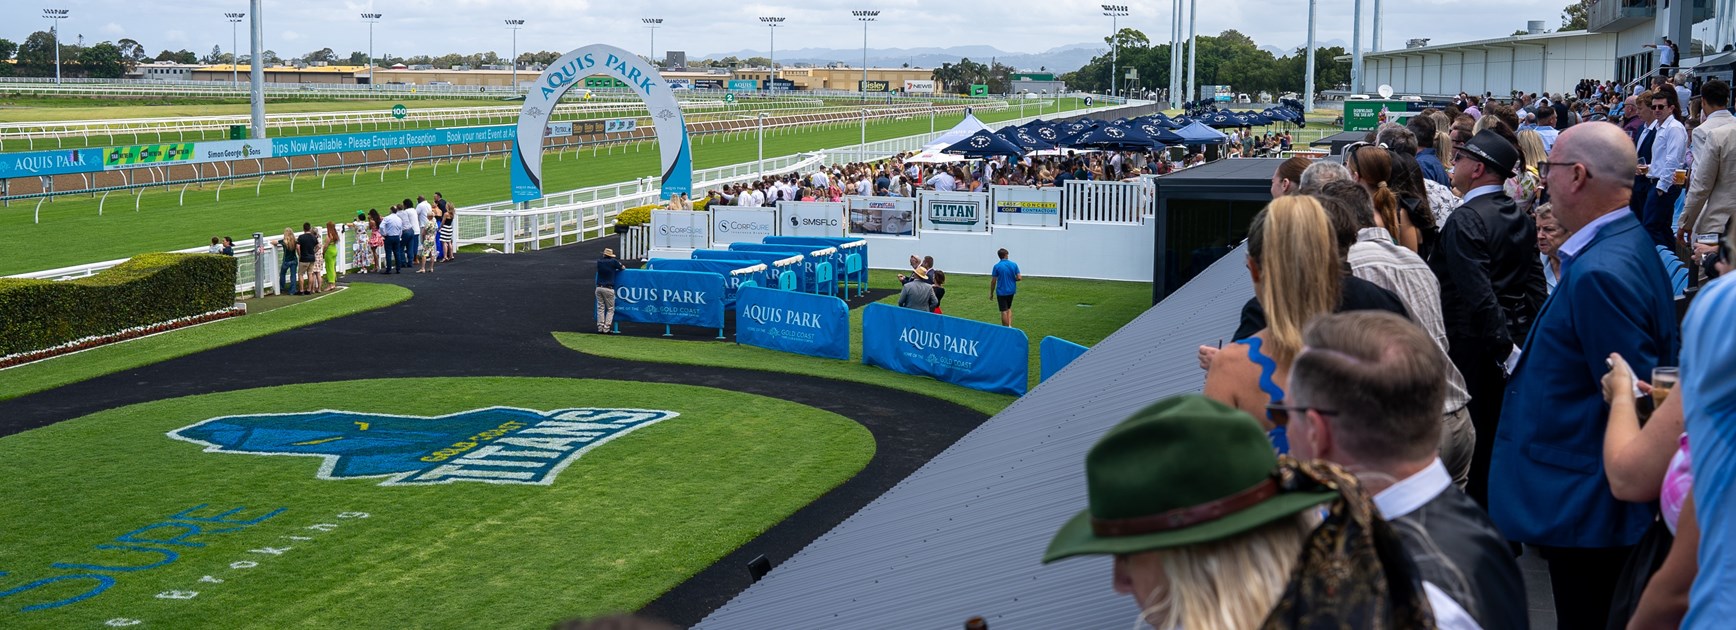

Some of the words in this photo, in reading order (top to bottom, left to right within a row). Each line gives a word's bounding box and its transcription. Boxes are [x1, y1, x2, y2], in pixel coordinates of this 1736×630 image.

[541, 53, 595, 101] AQUIS
[605, 53, 657, 96] PARK
[726, 93, 733, 101] 2
[1086, 98, 1091, 106] 2
[393, 107, 406, 115] 100
[291, 140, 308, 153] Now
[310, 138, 342, 151] Available
[349, 136, 370, 149] Please
[373, 133, 398, 148] Enquire
[398, 134, 405, 144] at
[407, 131, 437, 146] Reception
[447, 131, 461, 142] Book
[462, 131, 475, 143] your
[476, 129, 487, 139] next
[488, 127, 502, 139] Event
[208, 151, 224, 159] Simon
[225, 149, 242, 158] George
[249, 148, 261, 157] Sons
[14, 156, 53, 173] AQUIS
[933, 204, 975, 218] TITAN
[803, 218, 837, 227] SMSFLC
[615, 286, 658, 304] QUIS
[663, 289, 707, 305] PARK
[743, 304, 783, 325] AQUIS
[786, 309, 822, 329] PARK
[781, 329, 796, 337] GOLD
[797, 331, 815, 339] COAST
[899, 326, 941, 350] AQUIS
[943, 335, 980, 358] PARK
[940, 356, 953, 365] GOLD
[954, 359, 972, 369] COAST
[413, 410, 656, 481] TITANS
[419, 440, 478, 462] GOLD
